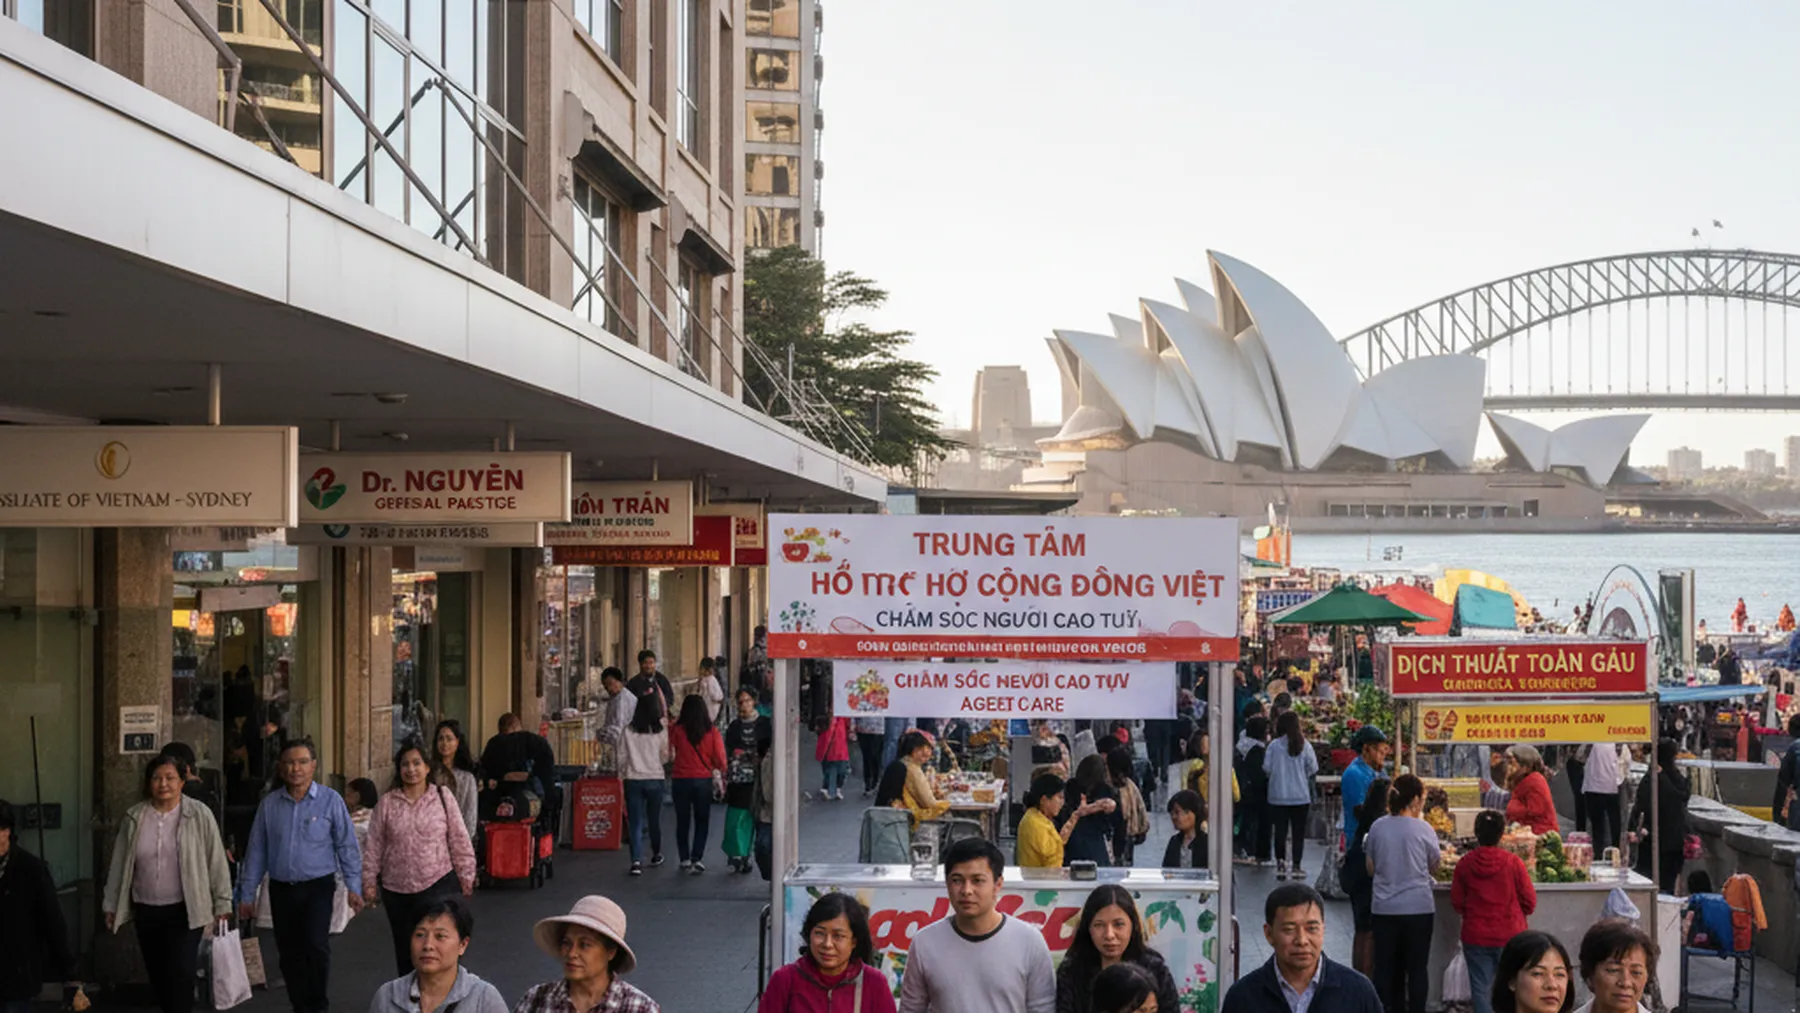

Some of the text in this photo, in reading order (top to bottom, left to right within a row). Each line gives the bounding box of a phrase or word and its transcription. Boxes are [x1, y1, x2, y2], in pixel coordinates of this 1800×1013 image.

[362, 471, 396, 492] Dr.
[67, 493, 90, 507] OF
[96, 492, 169, 507] VIETNAM
[186, 492, 252, 507] SYDNEY
[913, 533, 1015, 556] TRUNG
[1054, 613, 1095, 628] CAO
[1055, 675, 1090, 689] CAO
[1018, 696, 1064, 712] CARE
